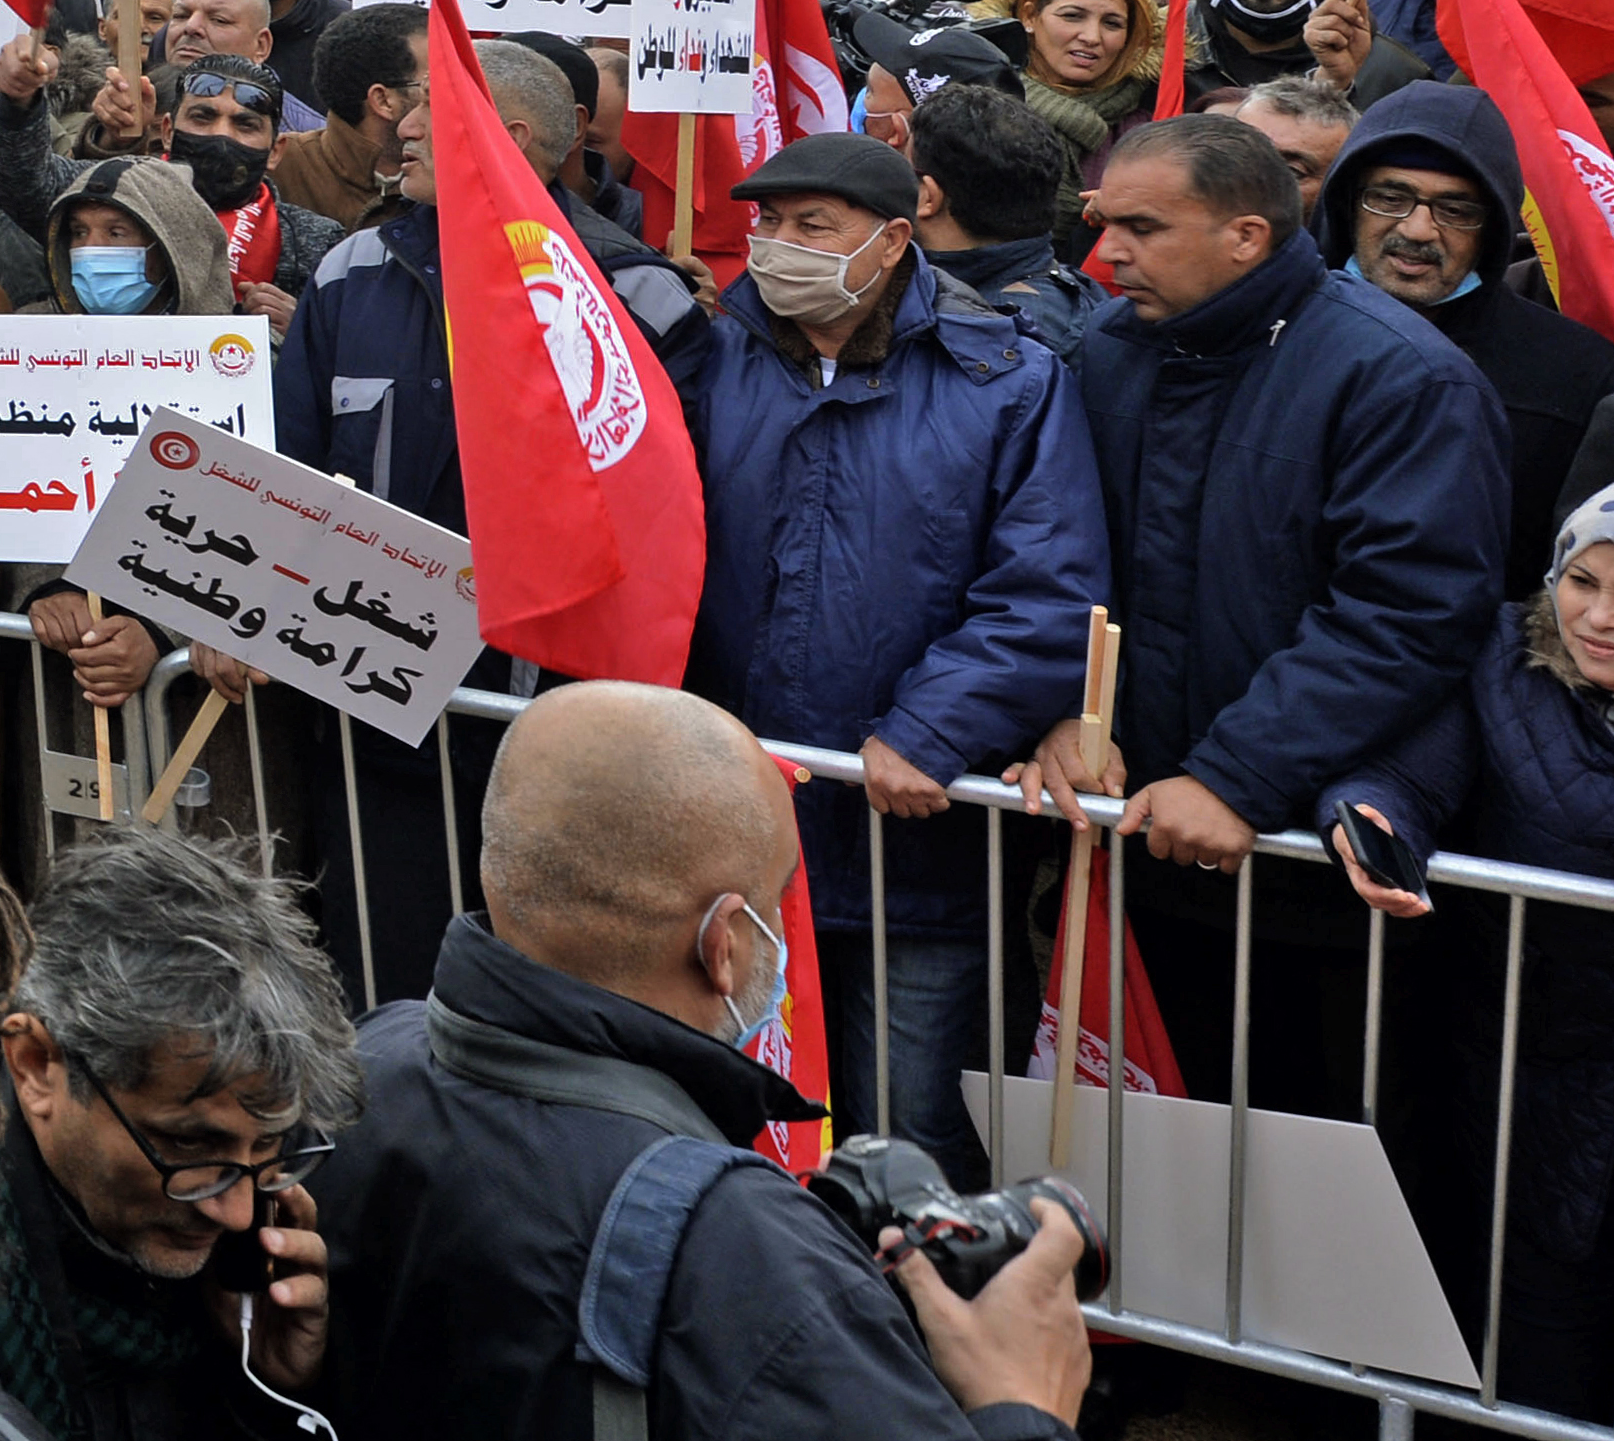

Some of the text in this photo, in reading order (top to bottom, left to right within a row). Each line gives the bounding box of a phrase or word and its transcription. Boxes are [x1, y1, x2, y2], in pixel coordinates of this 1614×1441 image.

[116, 538, 425, 707] كرامة وطنية
[143, 488, 440, 652] شغل حرية
